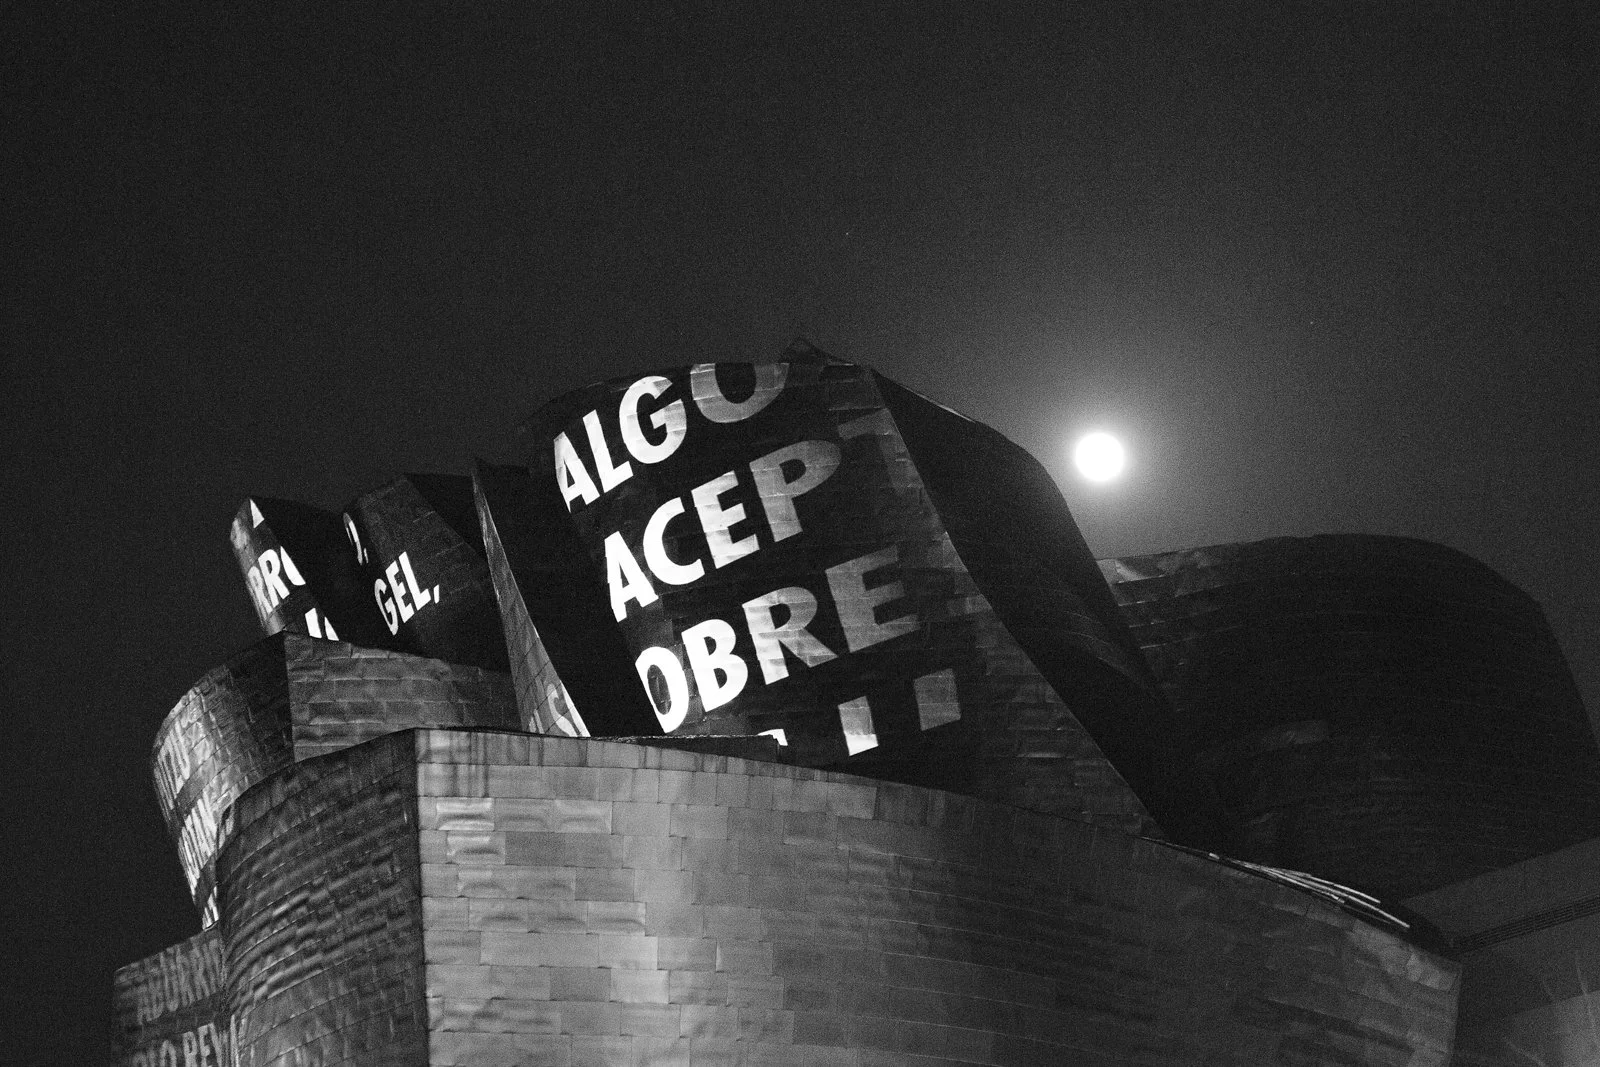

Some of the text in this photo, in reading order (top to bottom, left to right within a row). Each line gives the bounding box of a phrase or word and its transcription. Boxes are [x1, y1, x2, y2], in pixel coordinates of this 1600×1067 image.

[554, 362, 790, 513] ALGO
[374, 551, 440, 636] GEL,
[634, 546, 922, 734] OBRE
